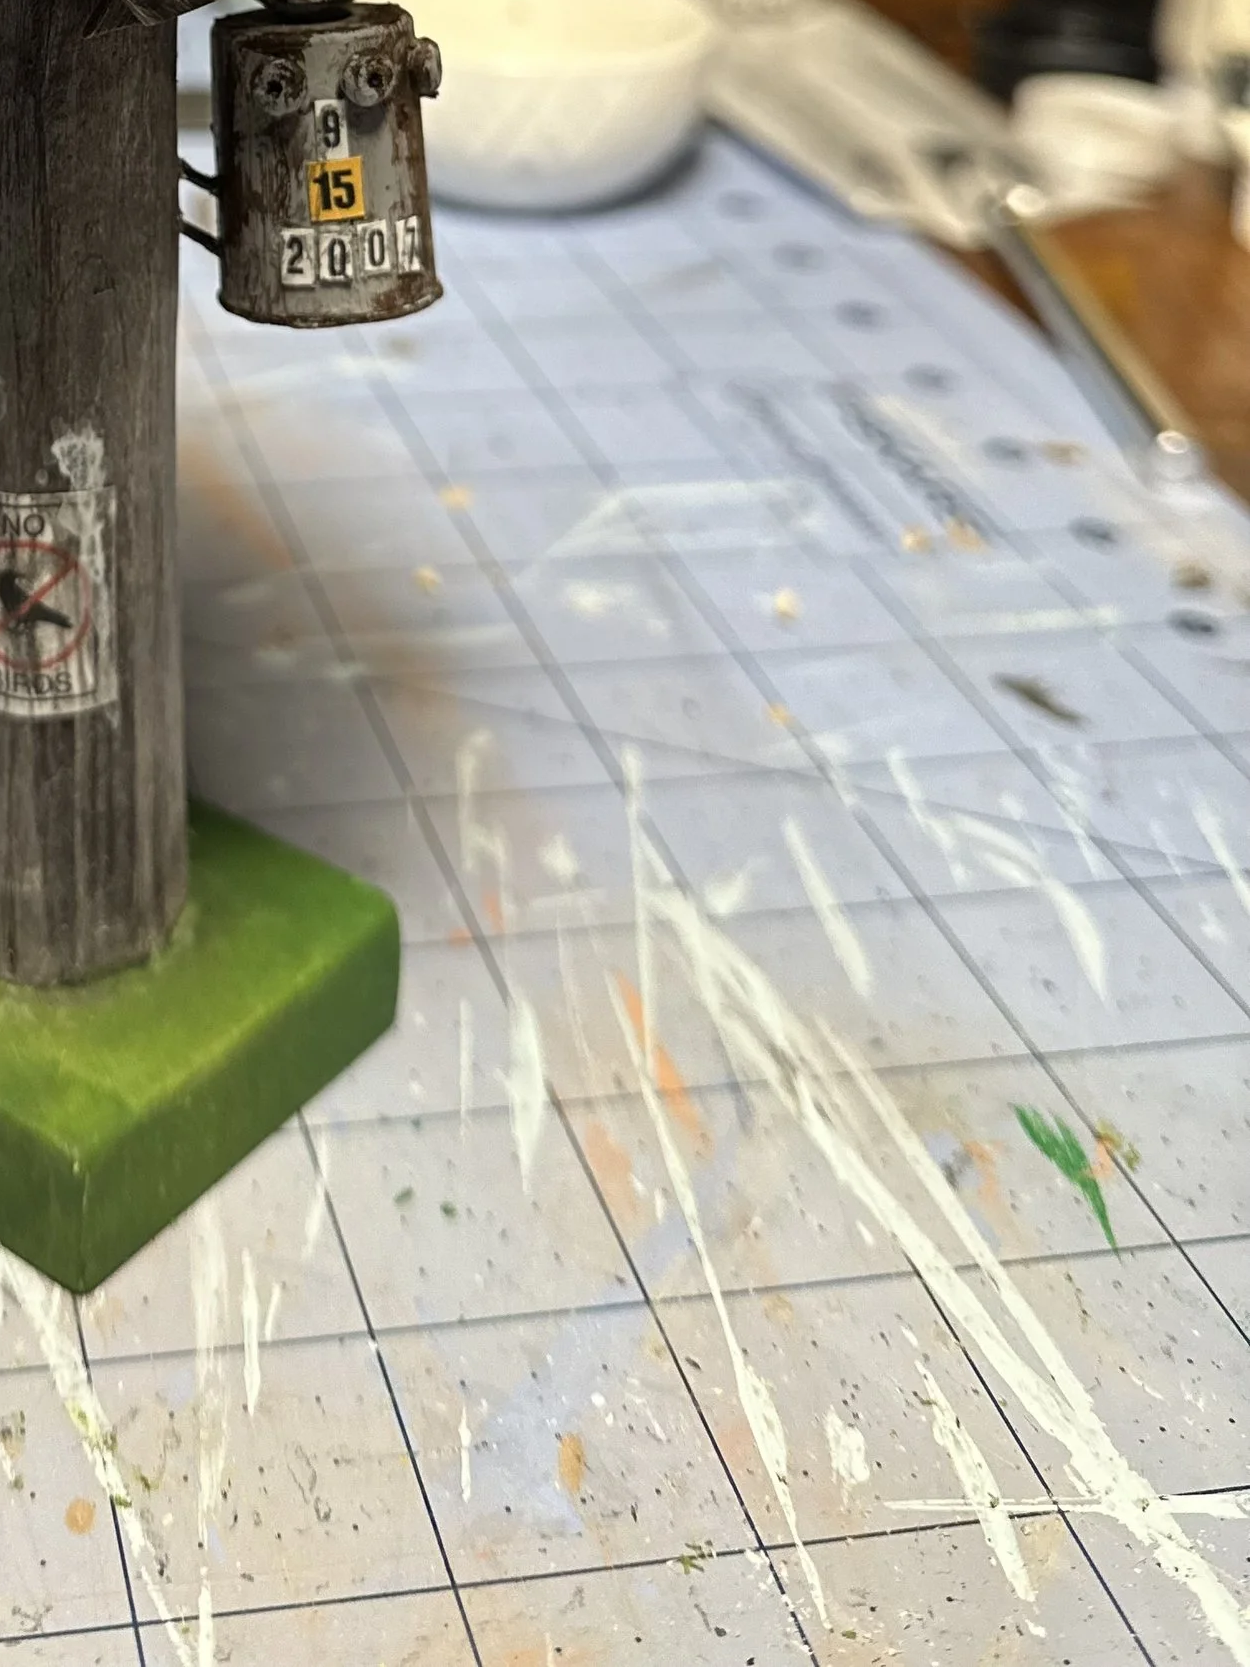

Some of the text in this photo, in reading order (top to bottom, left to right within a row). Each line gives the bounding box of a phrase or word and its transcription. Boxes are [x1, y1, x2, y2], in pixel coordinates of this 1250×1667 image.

[322, 108, 341, 148] 9
[312, 168, 357, 211] 15
[2, 513, 46, 537] NO
